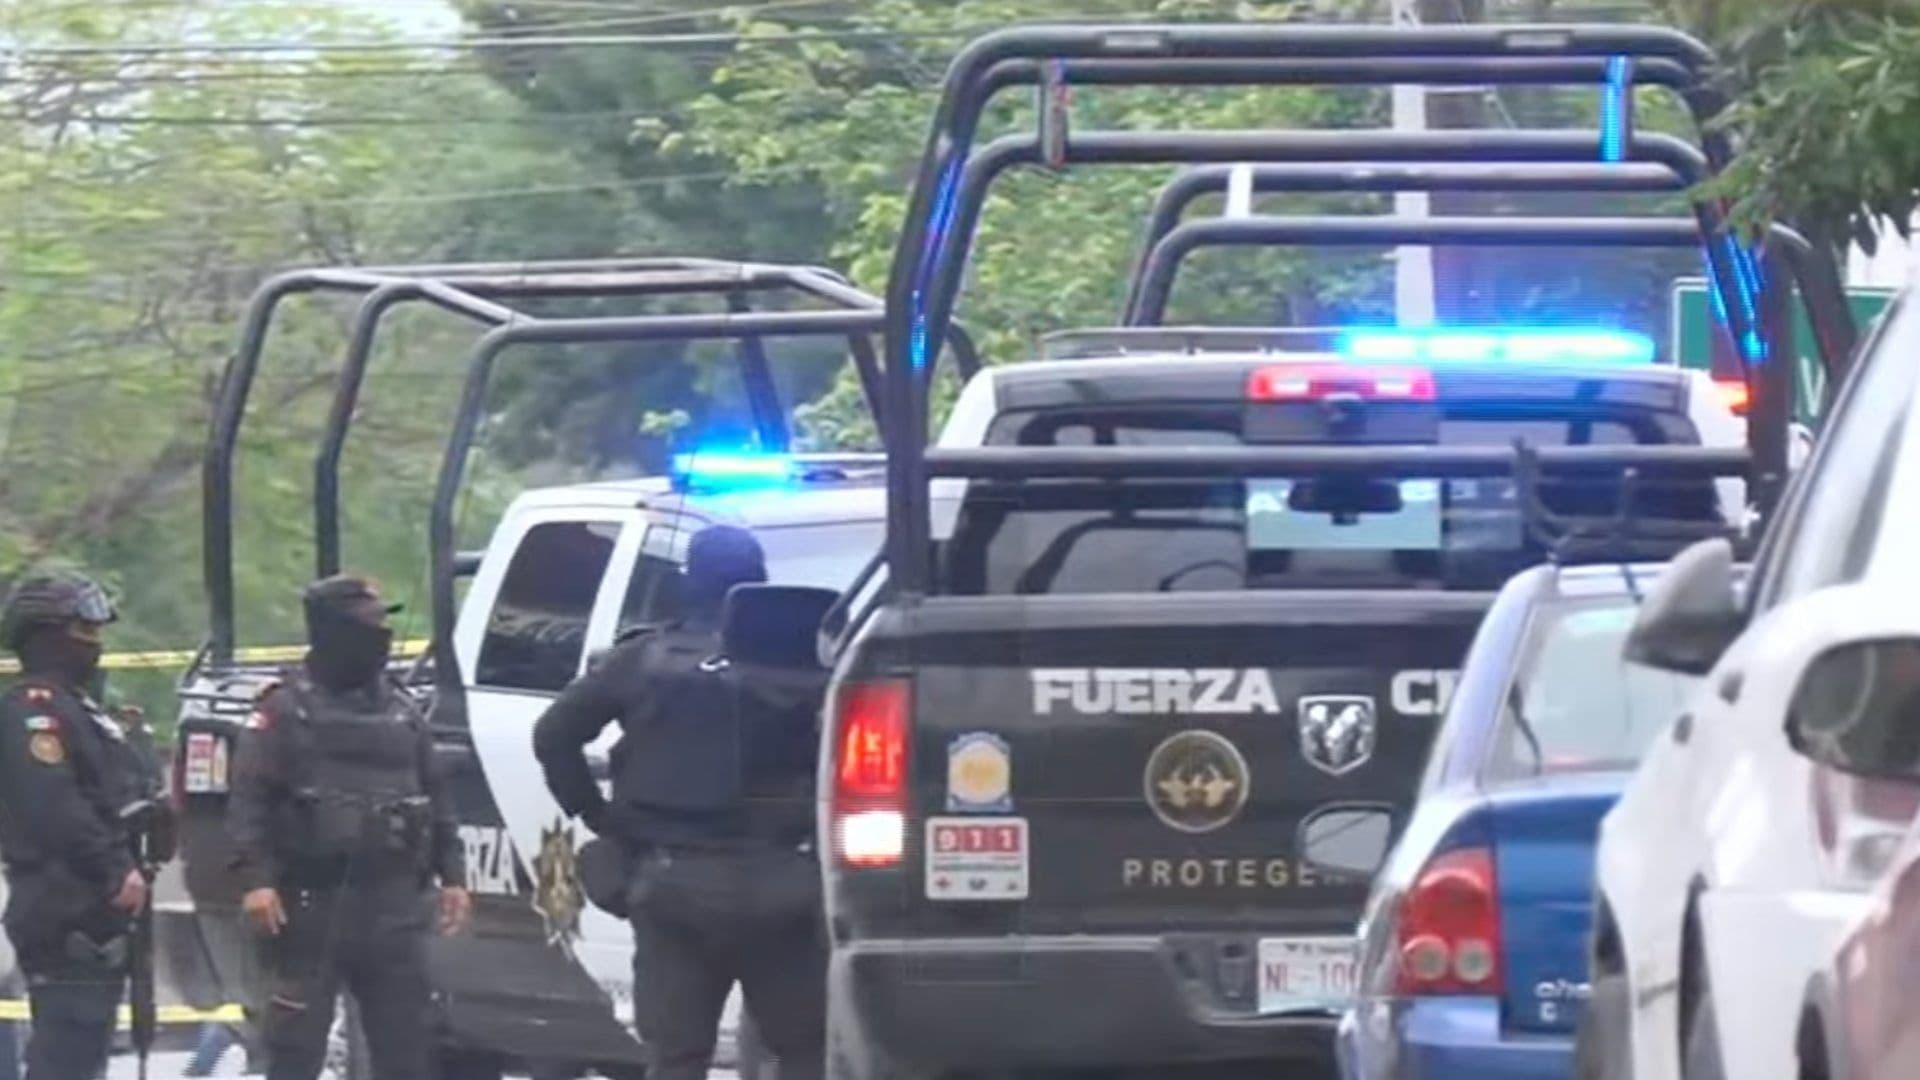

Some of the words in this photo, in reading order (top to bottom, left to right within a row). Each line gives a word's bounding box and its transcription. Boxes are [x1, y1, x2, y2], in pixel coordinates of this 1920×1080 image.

[1031, 668, 1281, 713] FUERZA
[938, 828, 1015, 850] 911
[457, 825, 518, 895] RZA
[1122, 858, 1347, 887] PROTEGE
